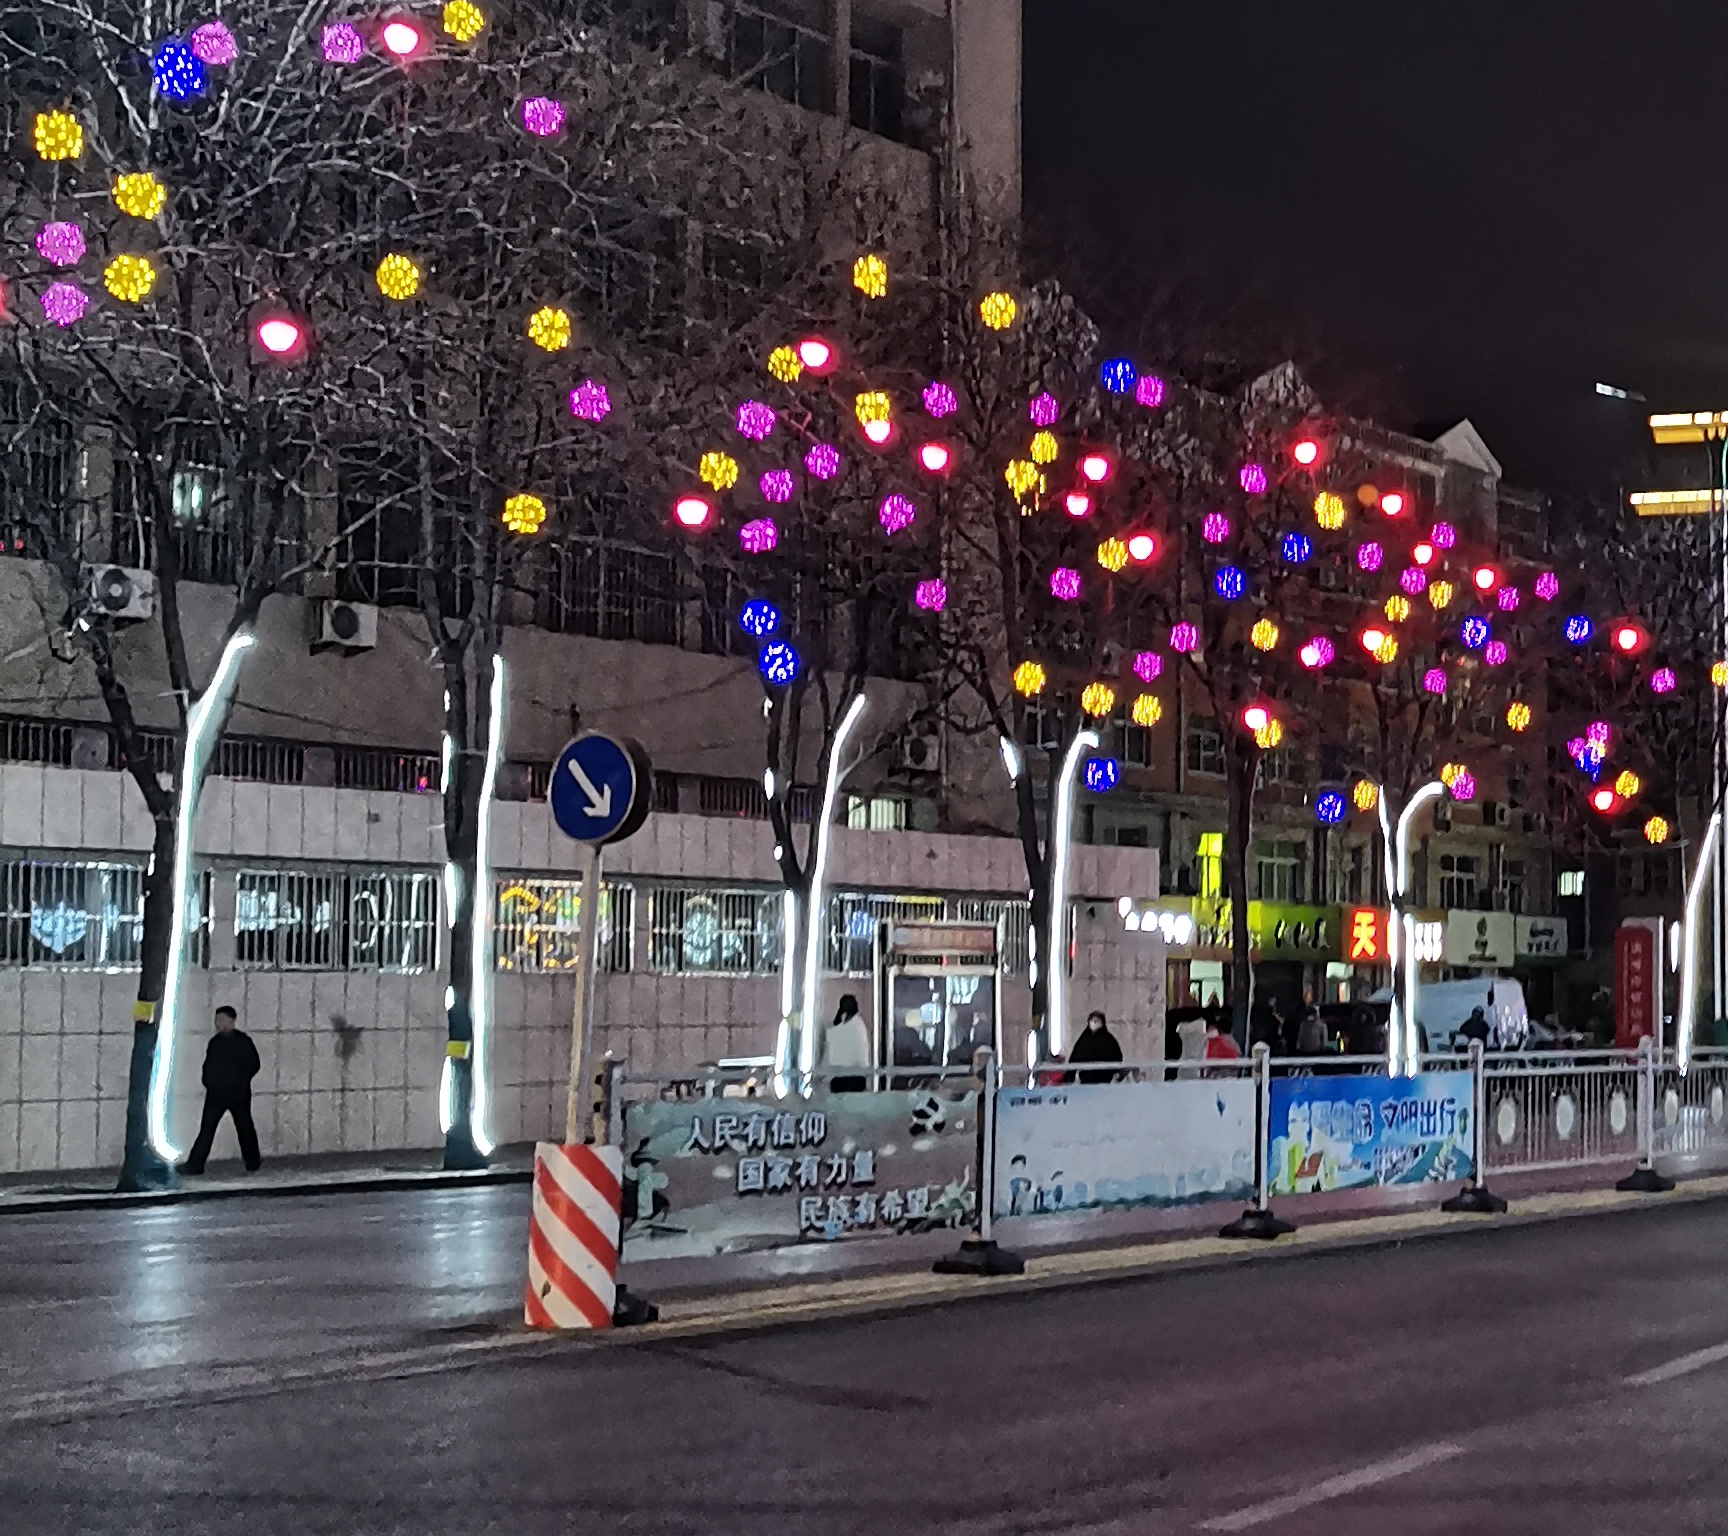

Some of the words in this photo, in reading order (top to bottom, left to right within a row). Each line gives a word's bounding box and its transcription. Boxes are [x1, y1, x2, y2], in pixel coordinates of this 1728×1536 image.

[689, 1113, 826, 1152] 人民有信仰
[1379, 1097, 1456, 1137] 文明出行
[738, 1150, 875, 1192] 国家有力量
[801, 1188, 929, 1230] 民族有希望
